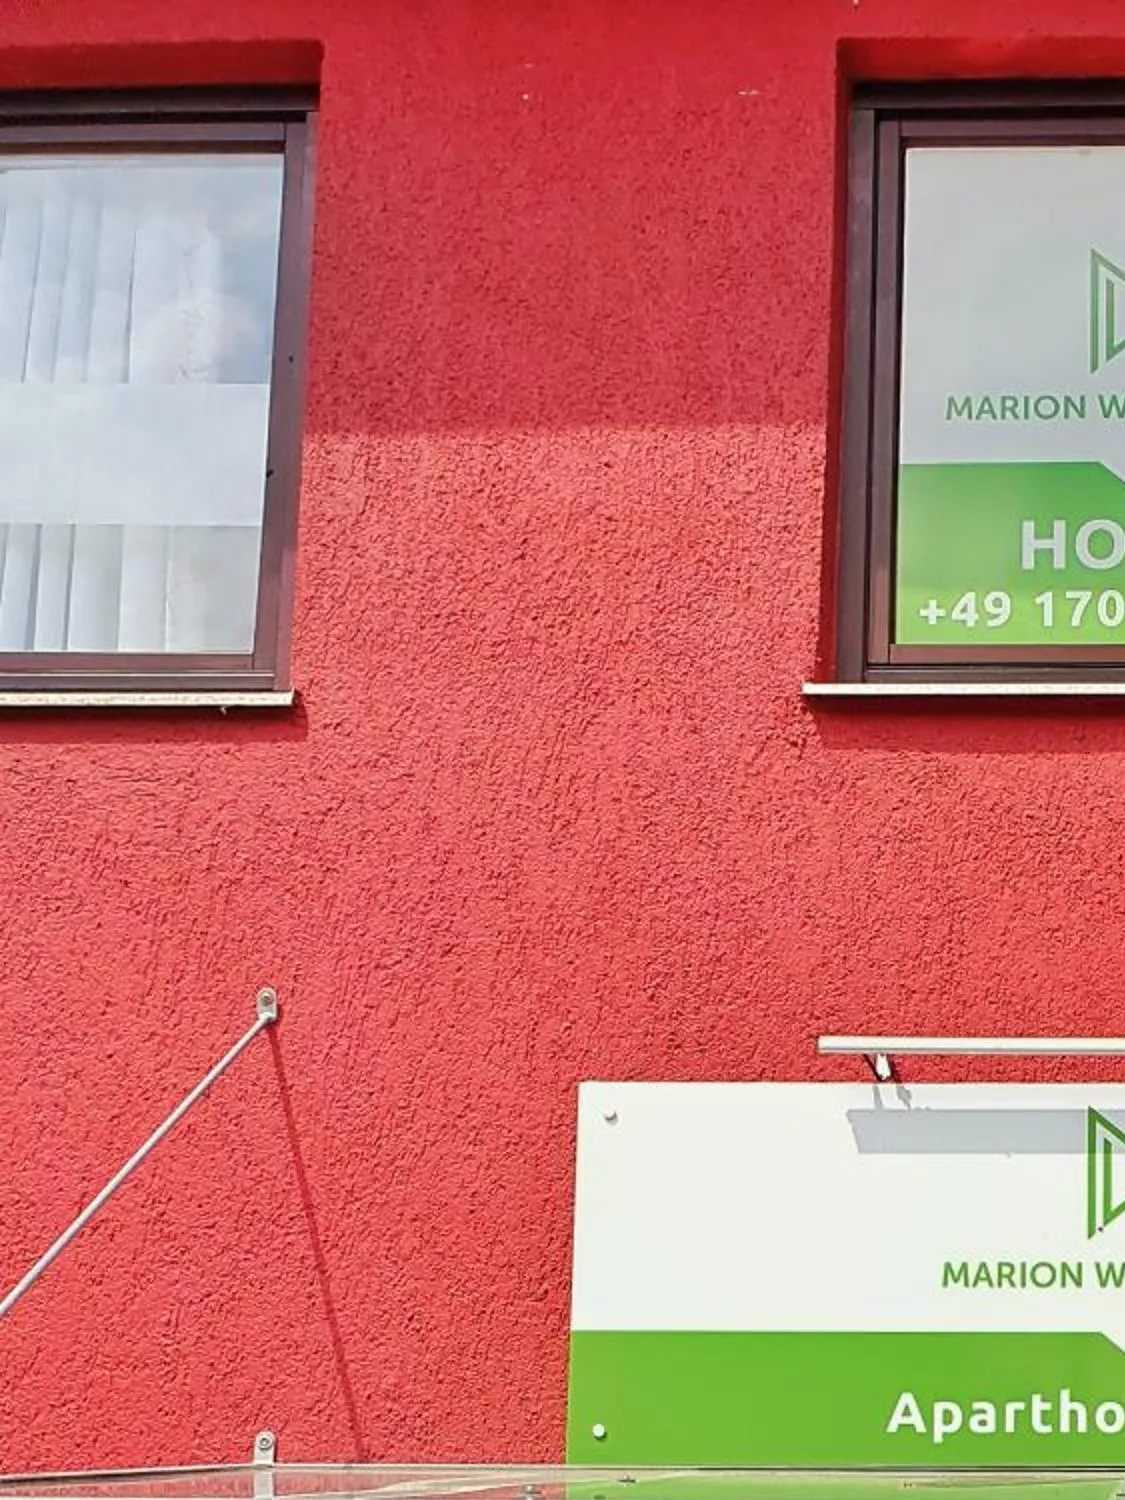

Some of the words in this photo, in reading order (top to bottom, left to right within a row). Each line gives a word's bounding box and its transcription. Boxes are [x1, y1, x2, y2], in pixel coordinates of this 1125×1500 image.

[945, 394, 1086, 421] MARION
[918, 591, 1012, 629] +49
[1034, 589, 1125, 628] 170
[941, 1260, 1084, 1289] MARION
